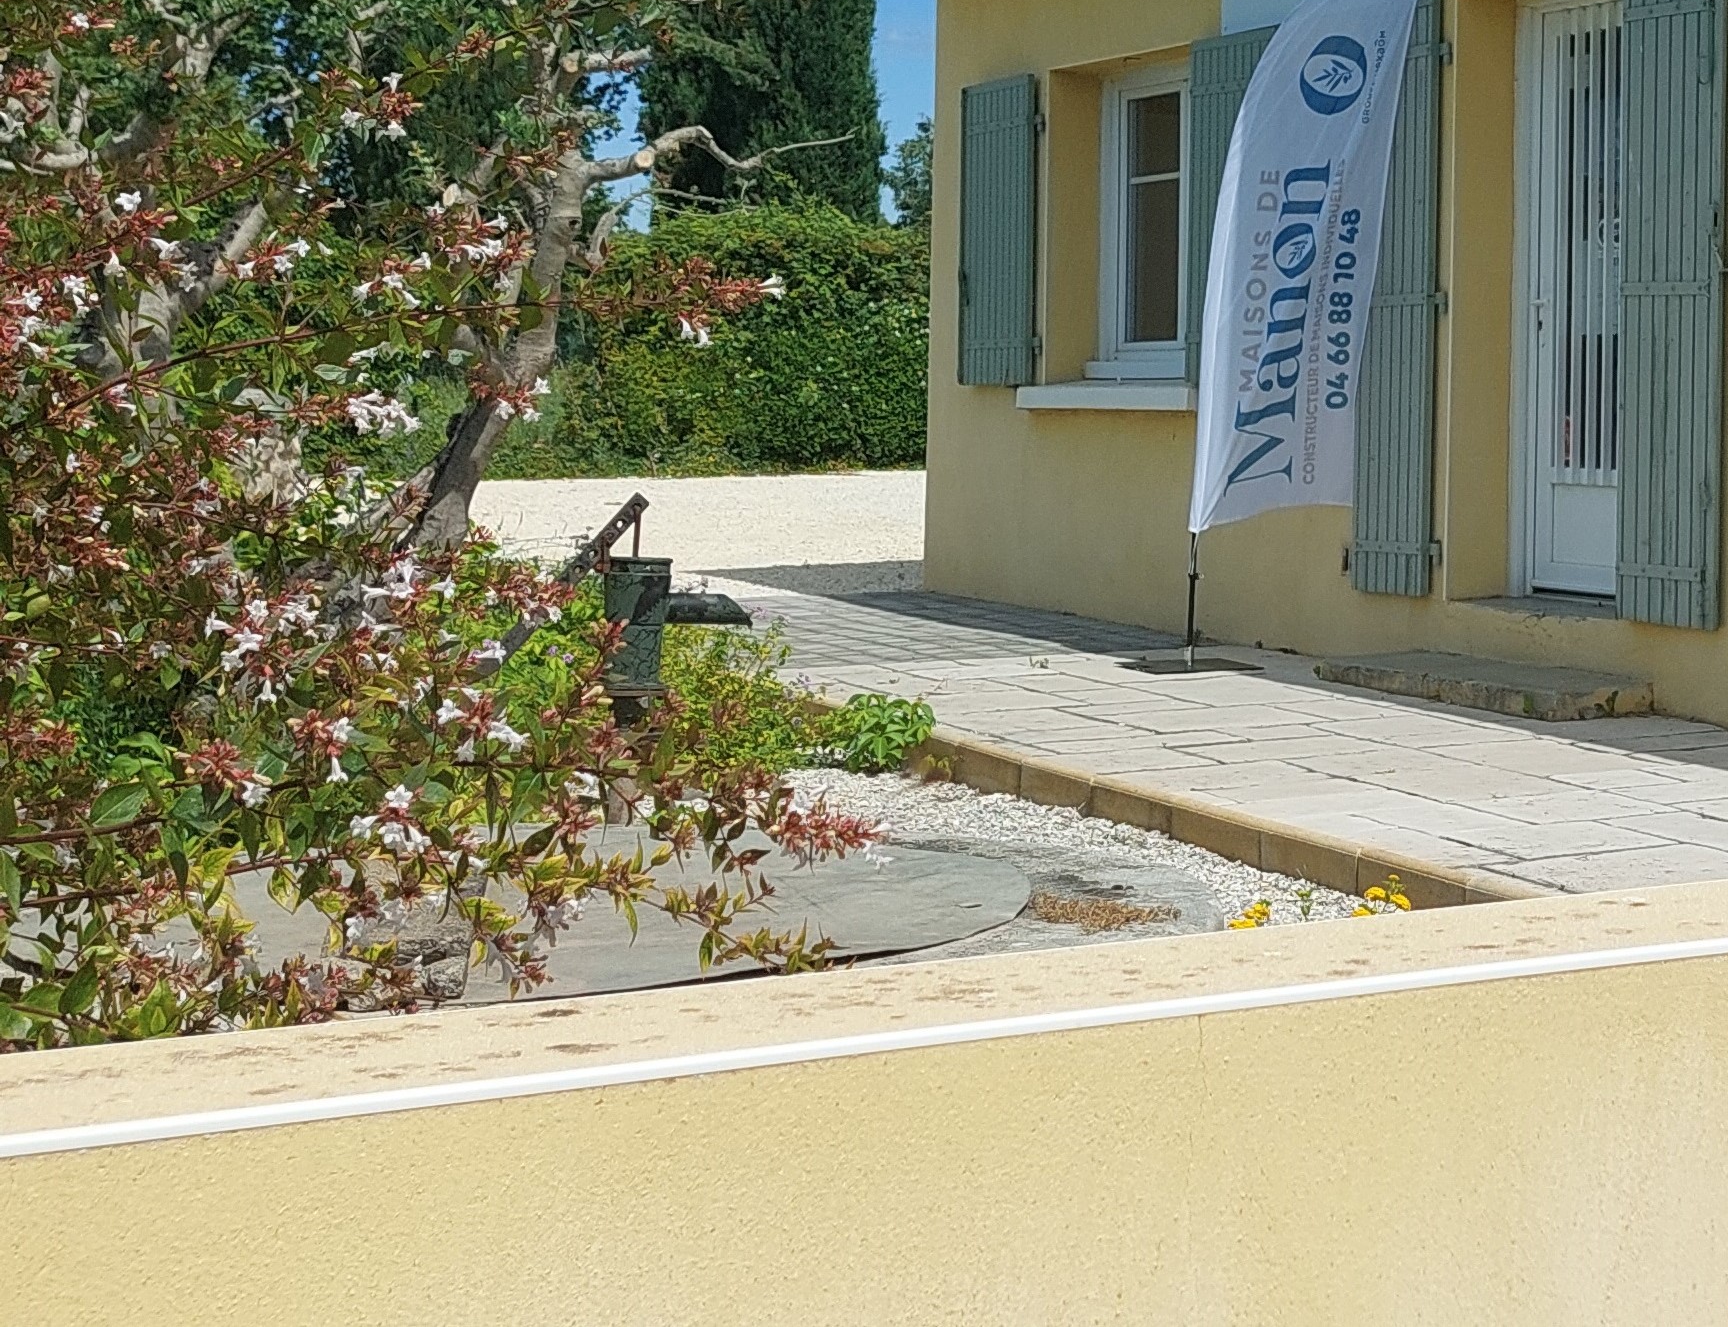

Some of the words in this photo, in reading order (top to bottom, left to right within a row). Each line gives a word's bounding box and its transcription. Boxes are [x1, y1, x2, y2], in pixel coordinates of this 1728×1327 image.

[1321, 158, 1346, 270] INDIVIDUELLES
[1339, 208, 1361, 244] 48
[1238, 230, 1273, 392] MAISONS
[1257, 169, 1280, 211] DE
[1333, 251, 1356, 284] 10
[1309, 273, 1328, 342] MAISONS
[1328, 291, 1353, 324] 88
[1224, 159, 1331, 497] Manon
[1308, 343, 1320, 364] DE
[1327, 331, 1350, 365] 66
[1325, 372, 1349, 410] 04
[1302, 367, 1320, 485] CONSTRUCTEUR
